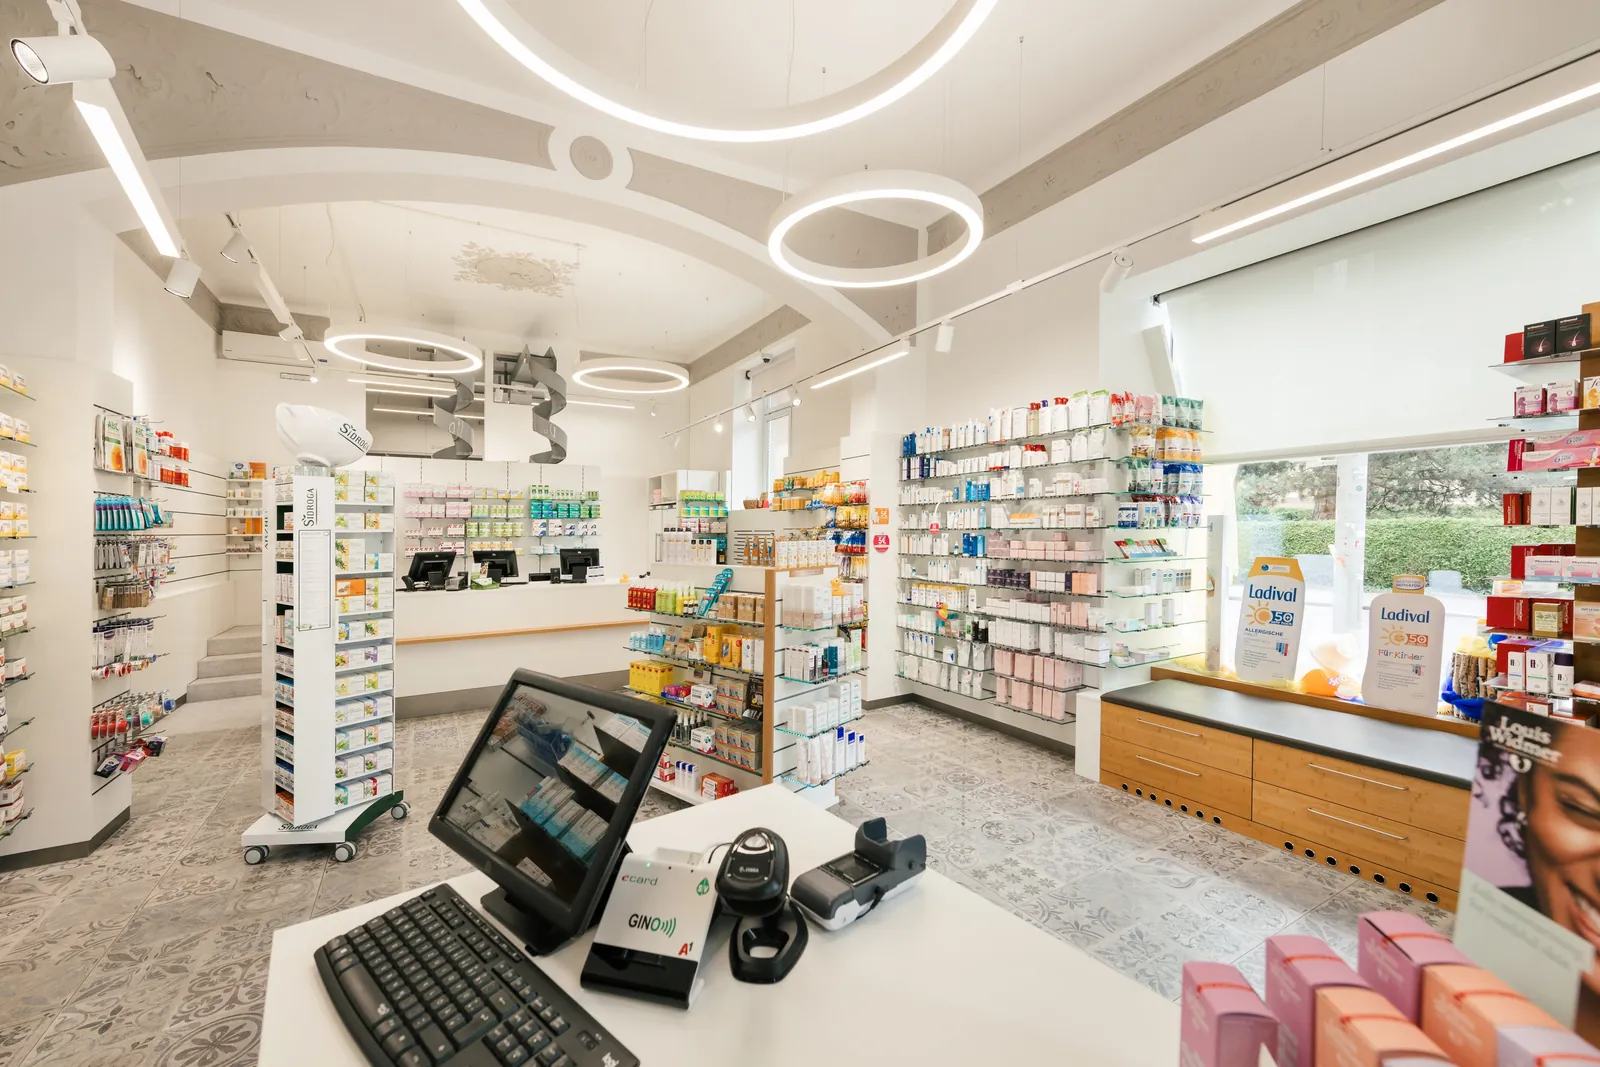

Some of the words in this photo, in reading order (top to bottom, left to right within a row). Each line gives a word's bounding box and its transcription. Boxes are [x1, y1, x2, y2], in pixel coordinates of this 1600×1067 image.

[302, 488, 315, 527] SIDROGA
[1249, 583, 1298, 603] Ladival
[1381, 606, 1430, 624] Ladival
[1244, 627, 1284, 637] ALLERGISCHE
[1394, 651, 1424, 661] Kinder
[1500, 715, 1551, 745] Louis
[1489, 725, 1562, 764] Widmer
[628, 913, 661, 932] GINO
